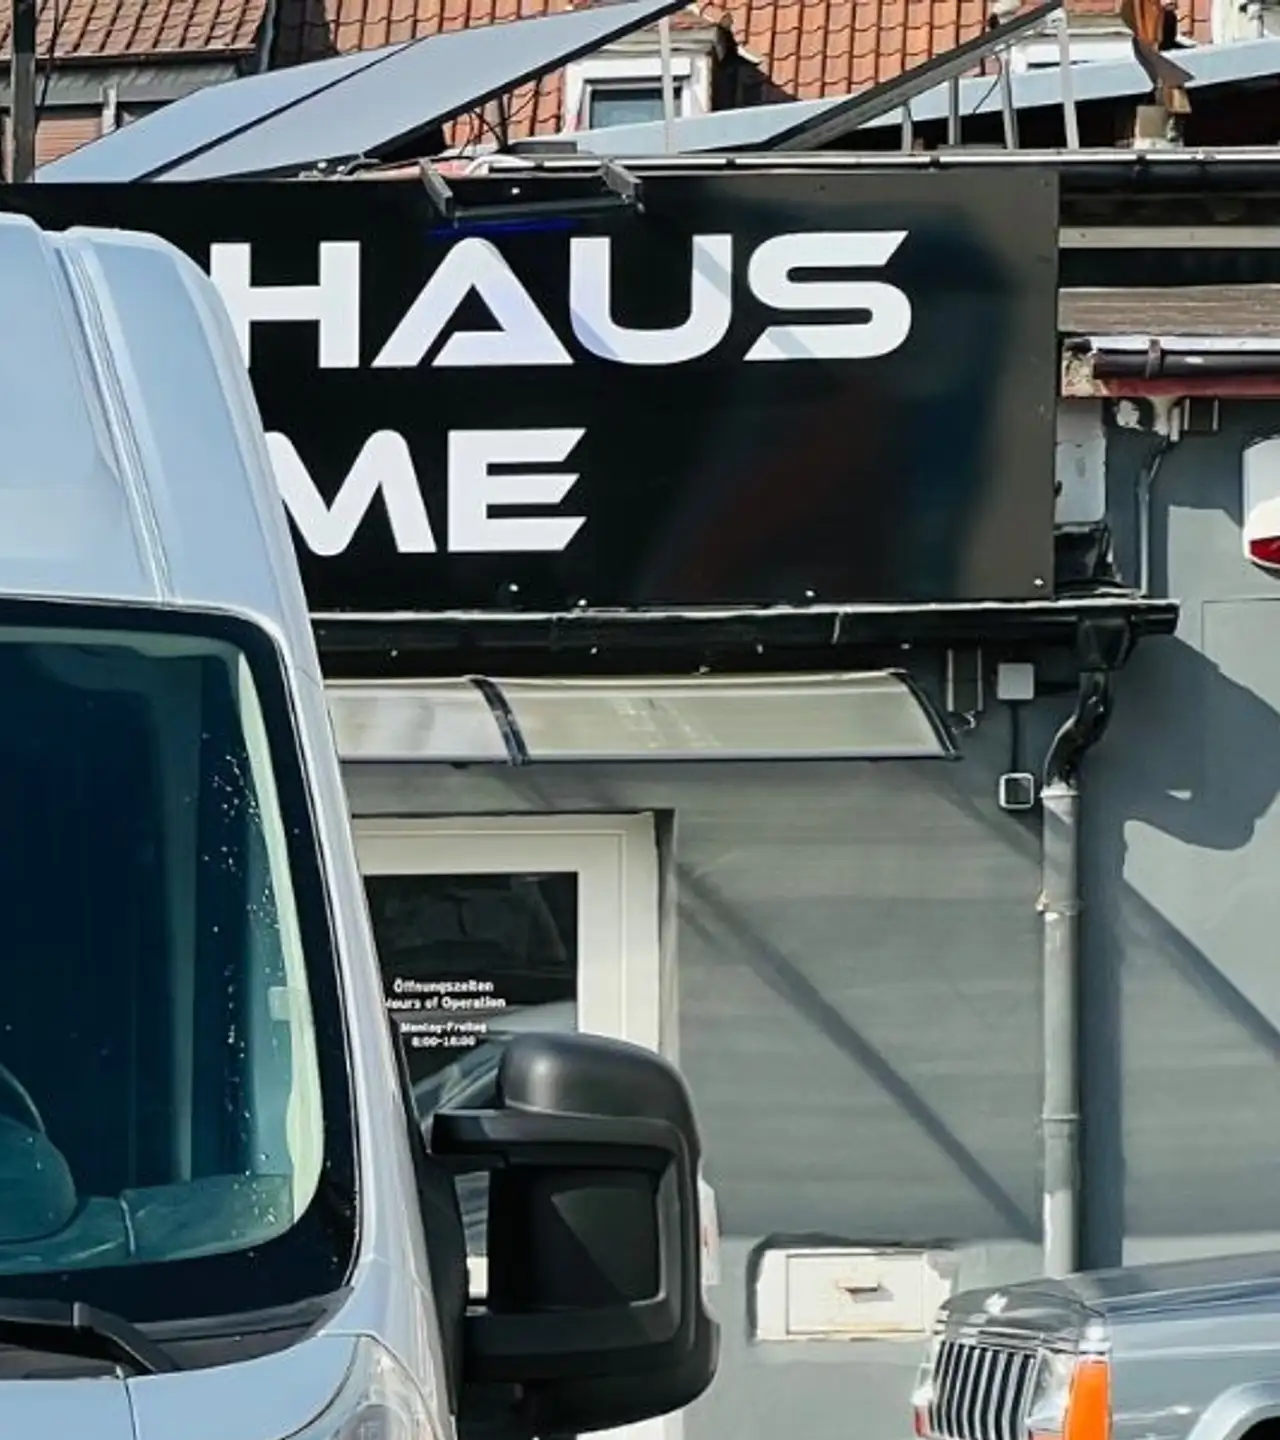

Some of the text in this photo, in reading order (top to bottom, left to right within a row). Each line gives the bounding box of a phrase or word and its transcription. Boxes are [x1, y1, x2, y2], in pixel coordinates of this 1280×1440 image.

[209, 230, 912, 369] HAUS
[425, 996, 438, 1009] of
[441, 996, 507, 1013] Operation
